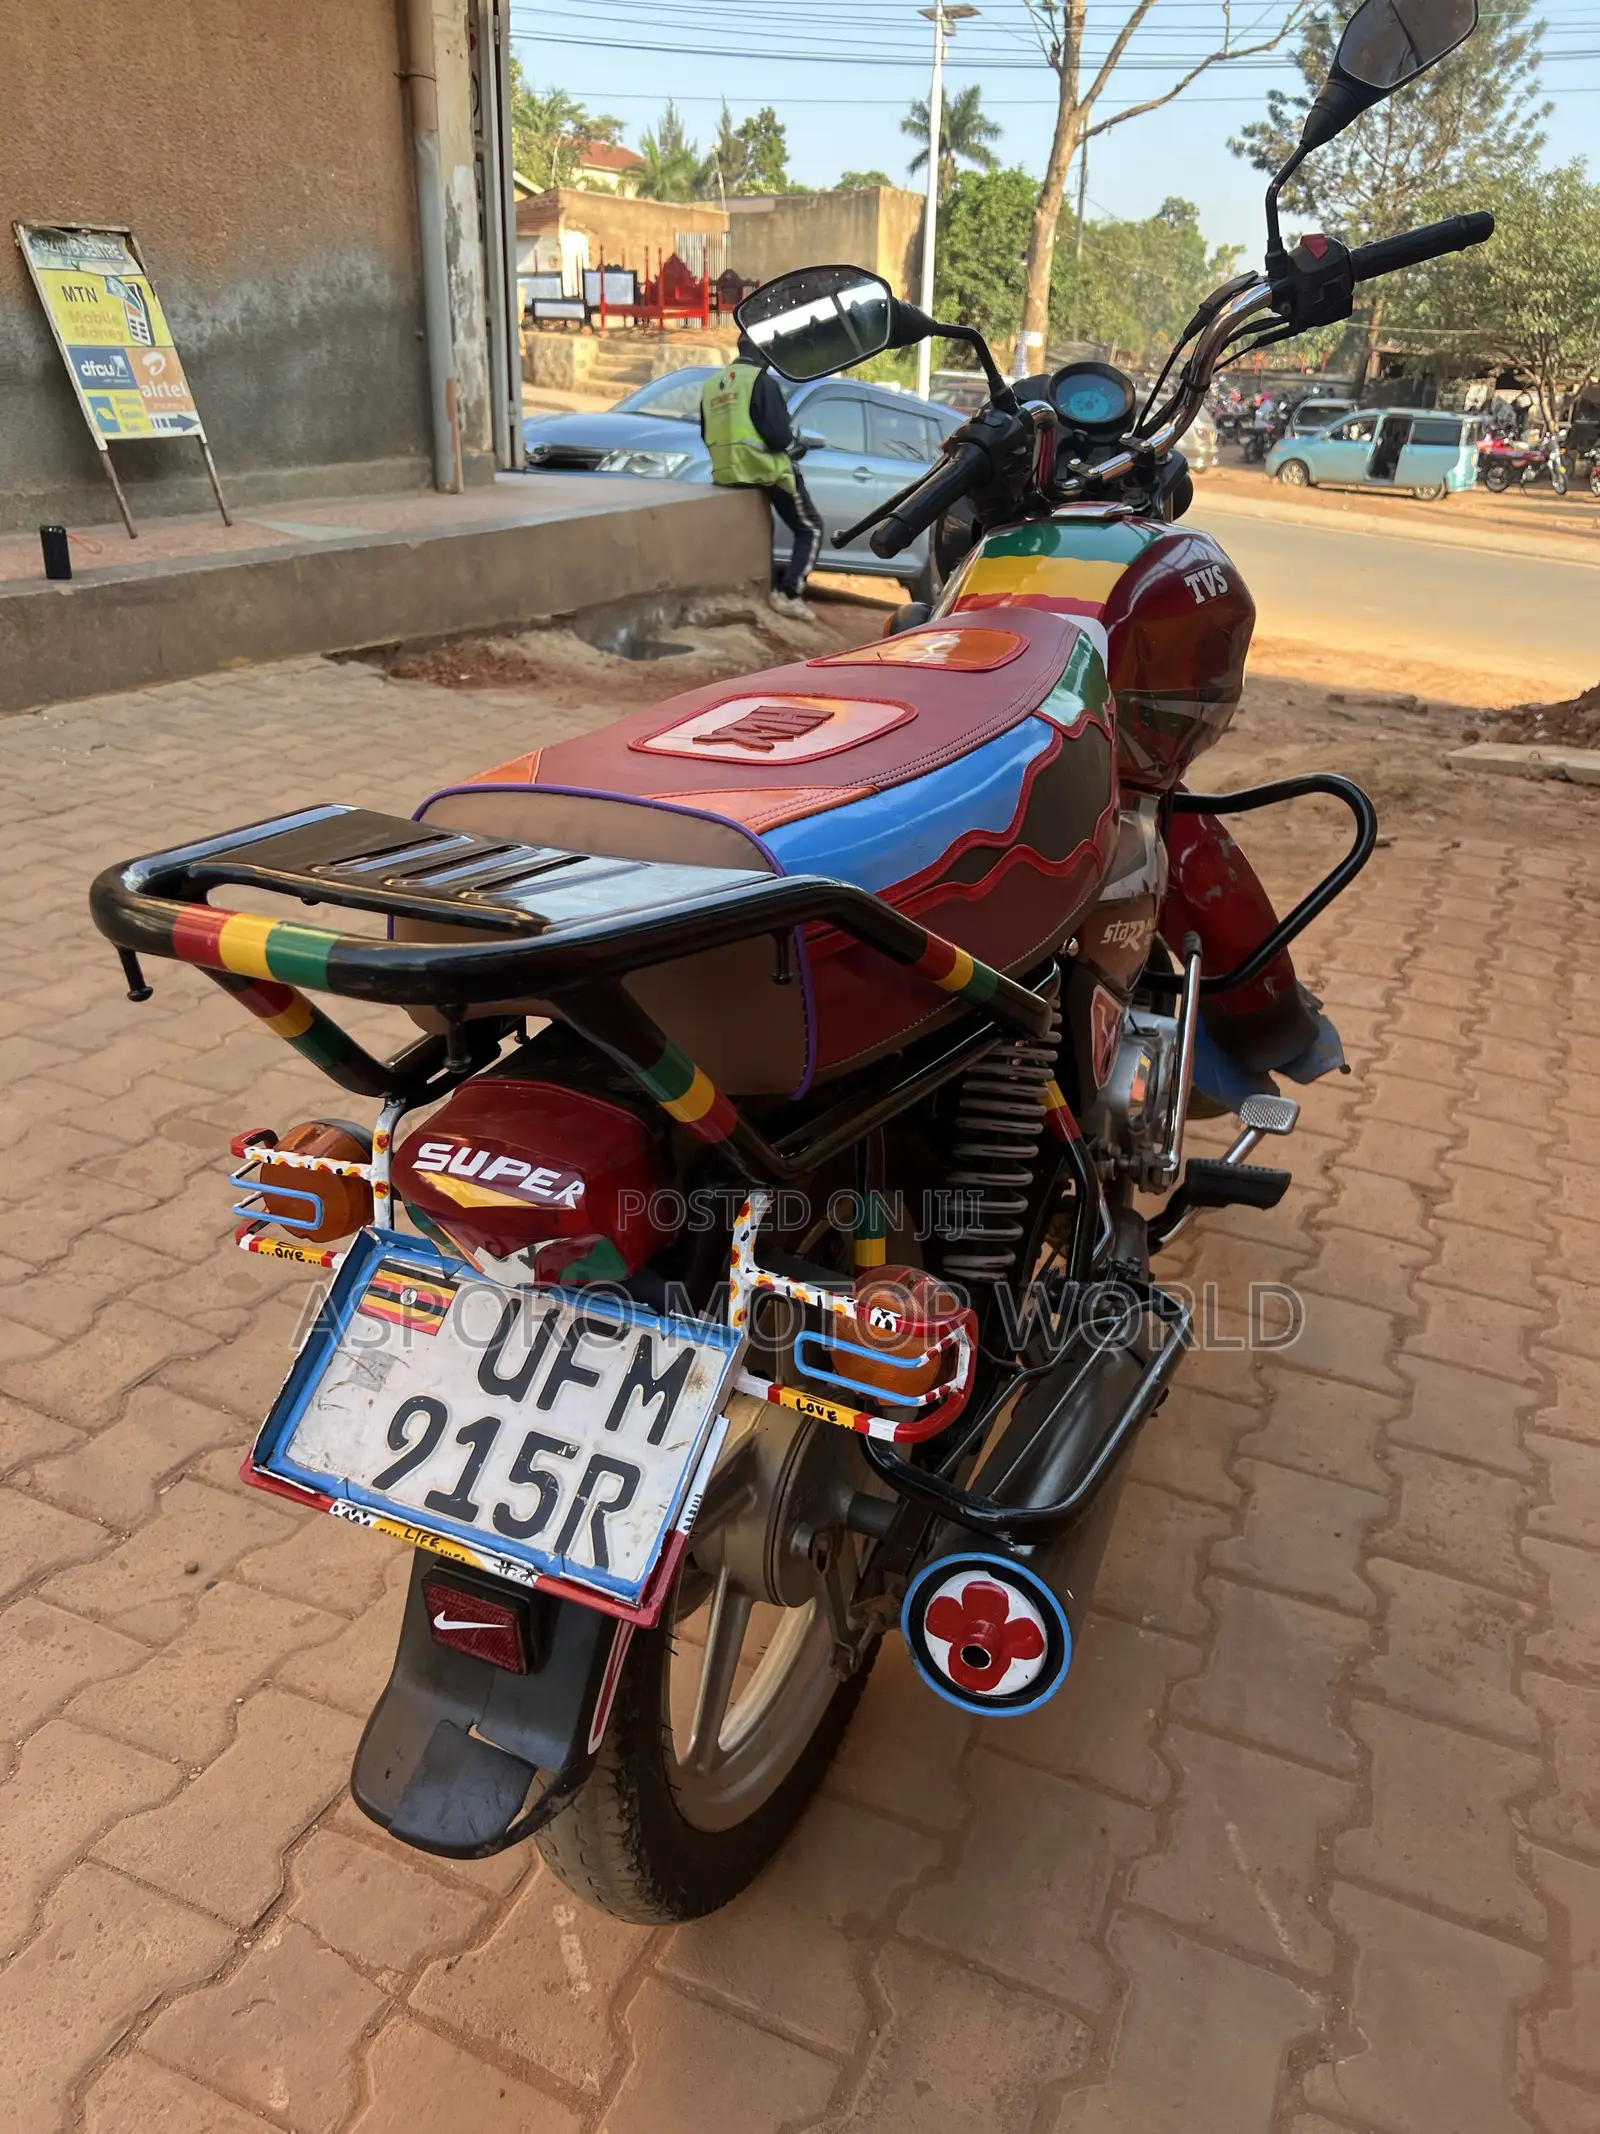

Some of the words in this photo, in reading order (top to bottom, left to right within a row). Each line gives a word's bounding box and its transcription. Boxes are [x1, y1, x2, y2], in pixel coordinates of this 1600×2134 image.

[61, 285, 99, 303] MTN
[68, 310, 121, 326] Mobile
[80, 360, 115, 377] dfcu
[141, 380, 191, 398] airtel
[1184, 564, 1228, 605] TVS
[411, 1142, 586, 1210] SUPER
[477, 1298, 698, 1447] UFM
[371, 1395, 642, 1570] 915R
